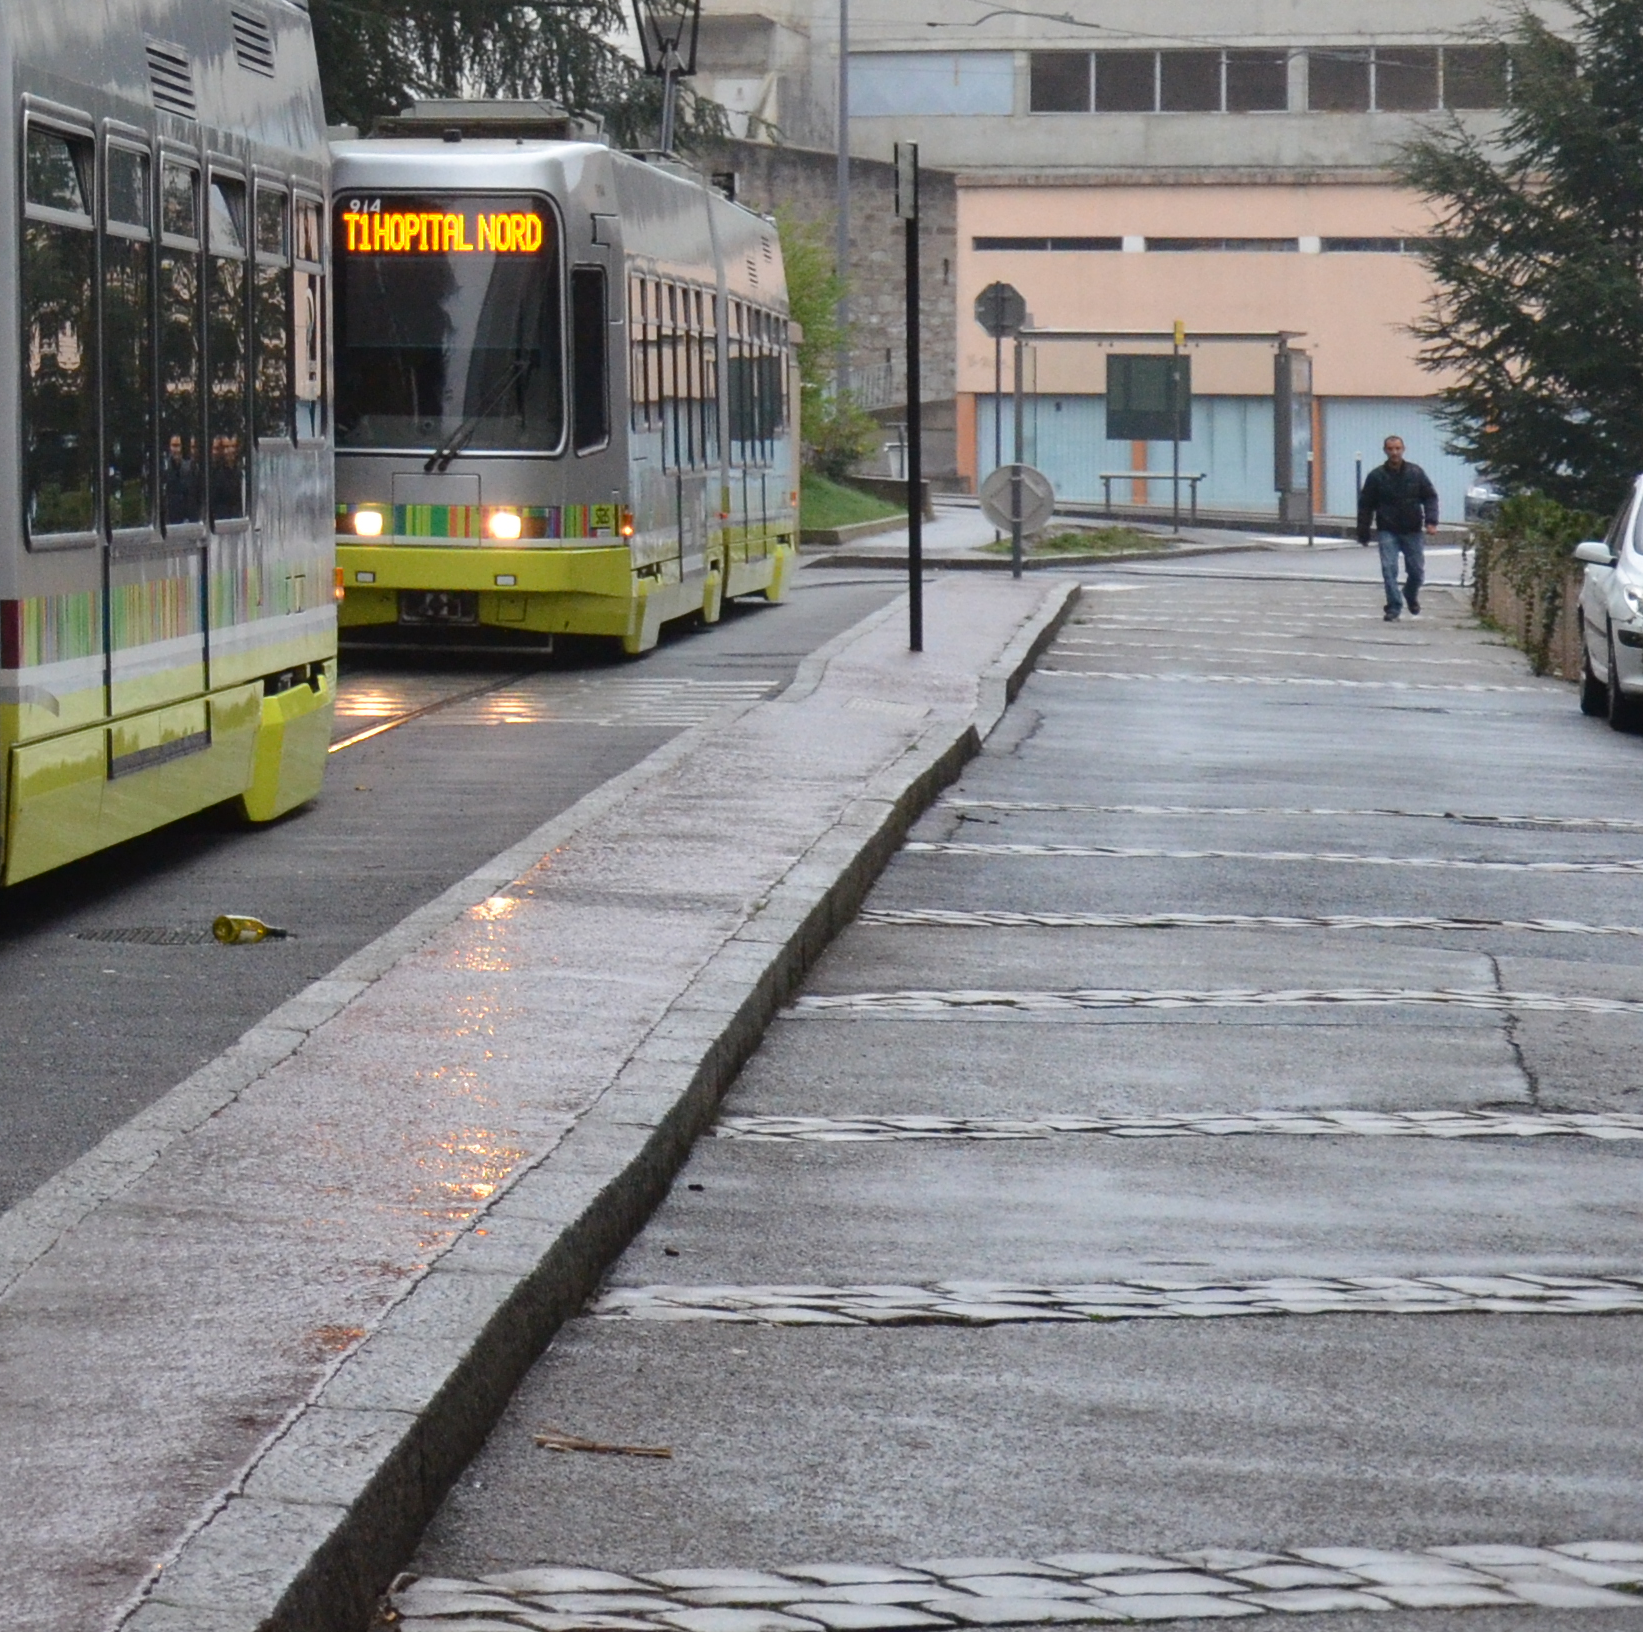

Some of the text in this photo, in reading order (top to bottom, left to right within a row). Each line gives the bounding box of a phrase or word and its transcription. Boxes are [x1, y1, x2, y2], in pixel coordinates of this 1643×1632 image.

[343, 214, 542, 251] T1 HOPITAL NORD
